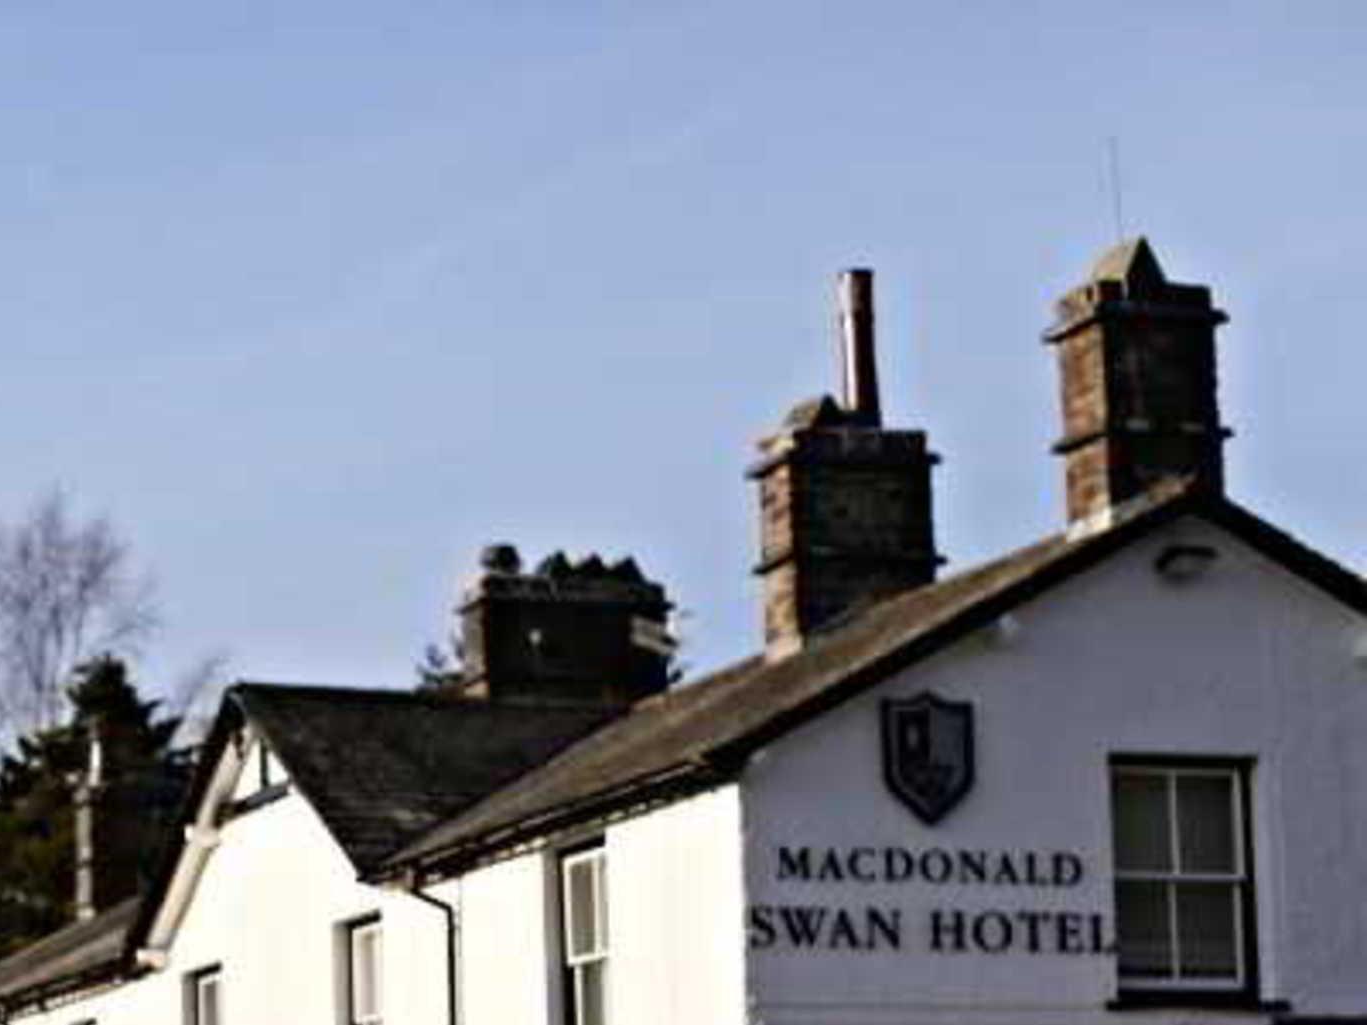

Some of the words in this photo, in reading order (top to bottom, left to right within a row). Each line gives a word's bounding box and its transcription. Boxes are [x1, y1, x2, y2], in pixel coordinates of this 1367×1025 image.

[777, 846, 1083, 887] MACDONALD
[750, 907, 901, 952] SWAN
[931, 913, 1116, 954] HOTEL
